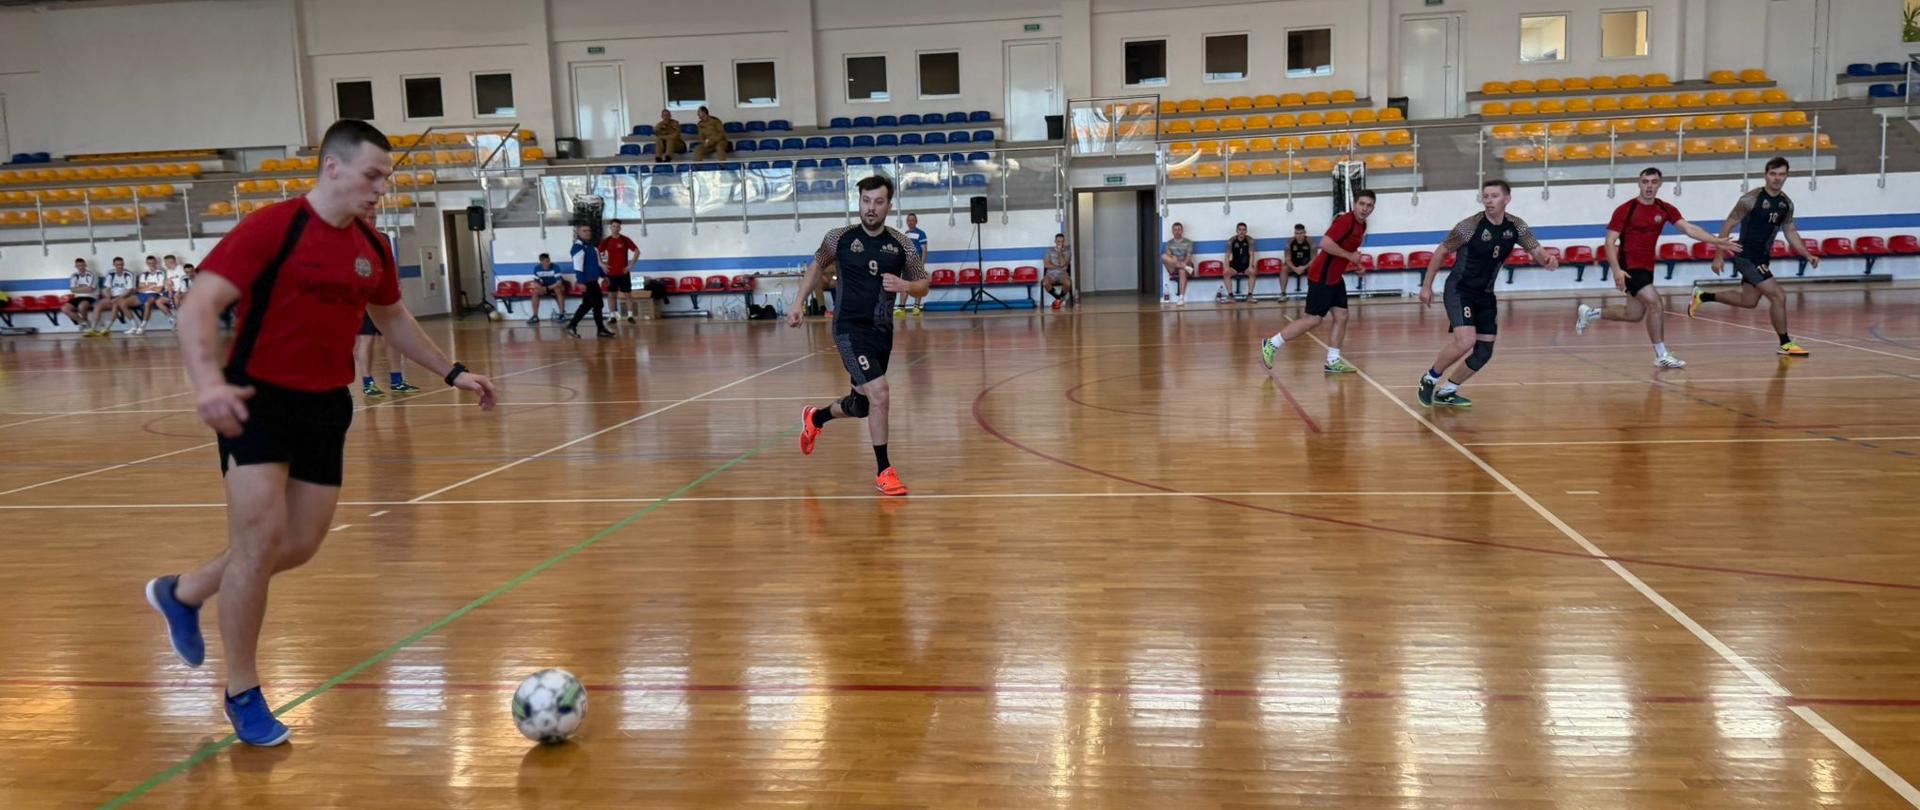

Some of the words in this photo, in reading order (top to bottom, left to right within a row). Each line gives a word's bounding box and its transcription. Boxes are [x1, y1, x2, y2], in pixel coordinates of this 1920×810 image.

[1492, 245, 1500, 258] 8
[868, 260, 878, 276] 9
[1463, 306, 1472, 318] 8
[858, 355, 870, 371] 9
